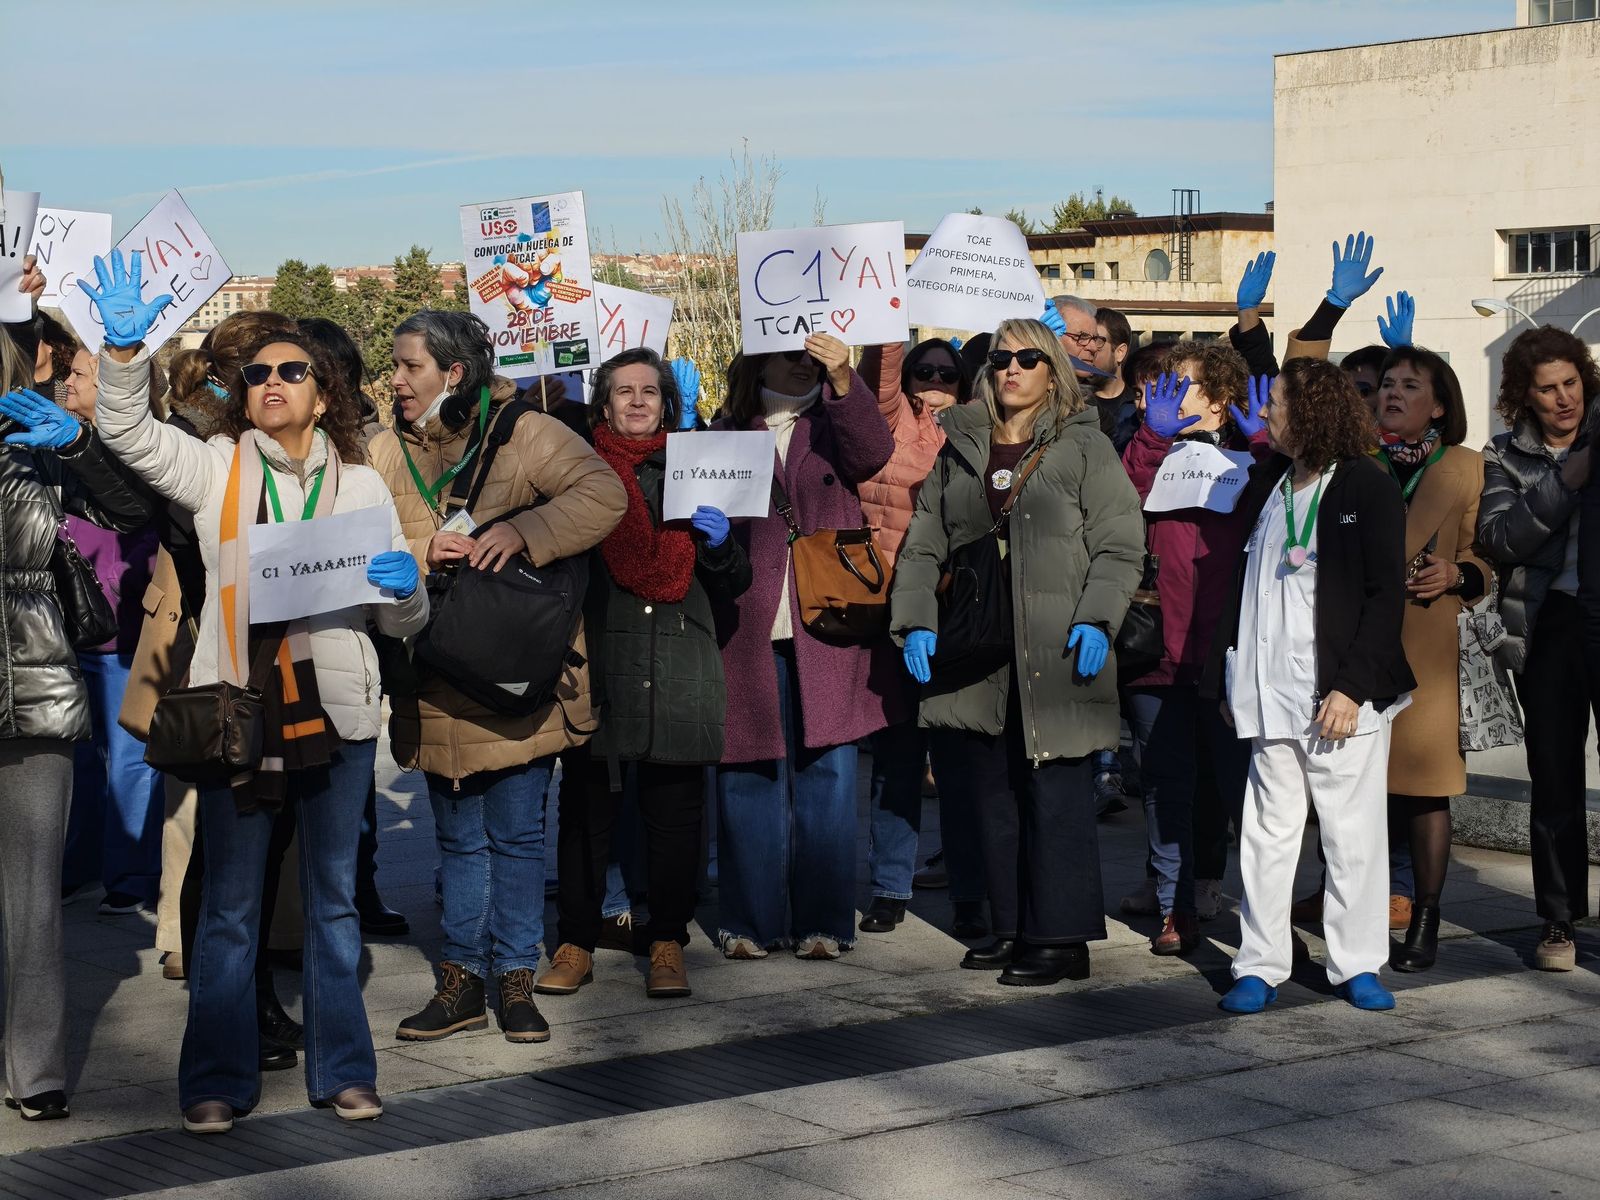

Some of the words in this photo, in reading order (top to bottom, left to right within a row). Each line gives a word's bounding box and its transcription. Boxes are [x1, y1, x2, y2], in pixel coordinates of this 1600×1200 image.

[39, 214, 76, 242] OY
[481, 219, 518, 237] USO
[474, 242, 522, 258] CONVOCAN
[526, 237, 559, 252] HUELGA
[562, 236, 574, 247] DE
[966, 234, 993, 247] TCAE
[36, 240, 53, 265] N
[514, 252, 536, 264] TCAE
[925, 247, 1012, 267] ¡PROFESIONALES
[1012, 257, 1026, 269] DE
[755, 249, 830, 306] C1
[831, 245, 901, 309] YA!
[950, 266, 997, 283] PRIMERA,
[907, 278, 963, 295] CATEGORÍA
[966, 283, 981, 296] DE
[982, 287, 1035, 304] SEGUNDA!
[507, 311, 528, 328] 28
[532, 306, 555, 324] DE
[754, 312, 827, 335] TCAE
[487, 321, 581, 347] NOVIEMBRE
[672, 470, 684, 481] C1
[690, 467, 753, 480] YAAAA!!!!
[1162, 471, 1176, 481] C1
[1182, 469, 1240, 486] YAAAA!!!!
[262, 567, 280, 579] C1
[289, 554, 368, 577] YAAAA!!!!
